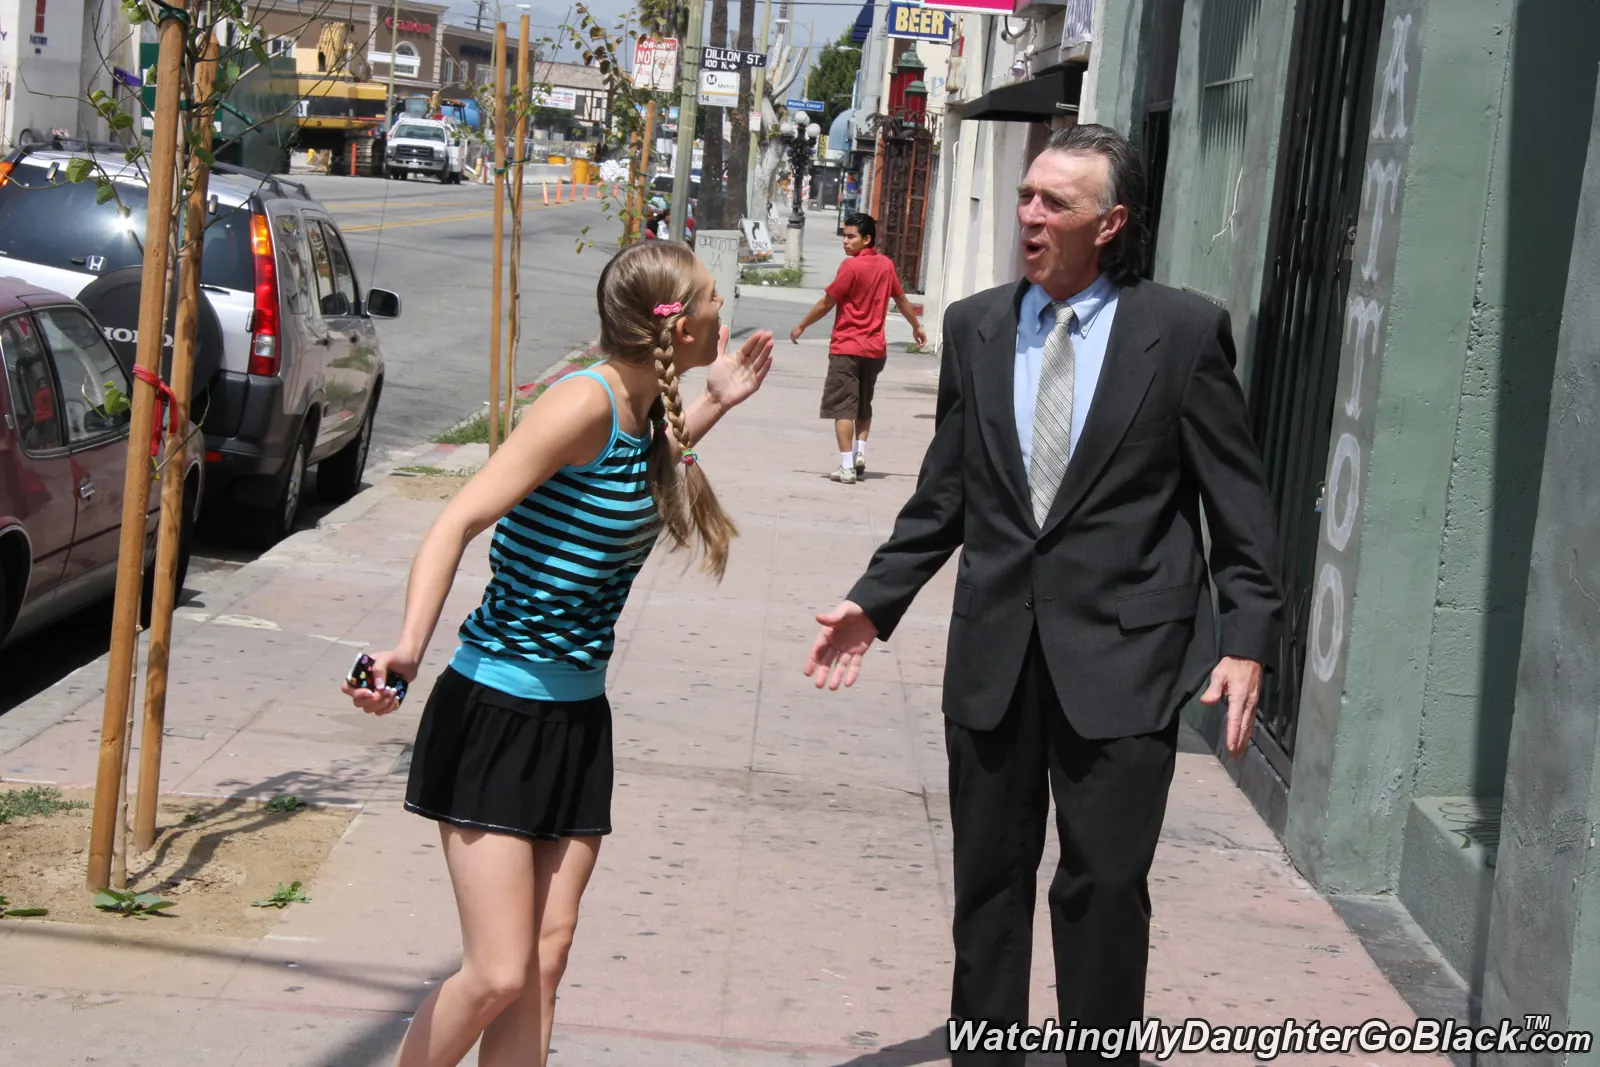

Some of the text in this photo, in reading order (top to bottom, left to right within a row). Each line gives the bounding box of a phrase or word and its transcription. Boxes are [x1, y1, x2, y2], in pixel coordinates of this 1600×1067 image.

[384, 16, 432, 34] Canon
[895, 6, 944, 35] BEER
[639, 40, 674, 51] OW-AWAY
[636, 50, 651, 64] NO
[704, 48, 763, 66] DILLON ST.
[704, 59, 718, 68] 100
[752, 240, 769, 249] ONLY
[101, 326, 175, 348] HOD
